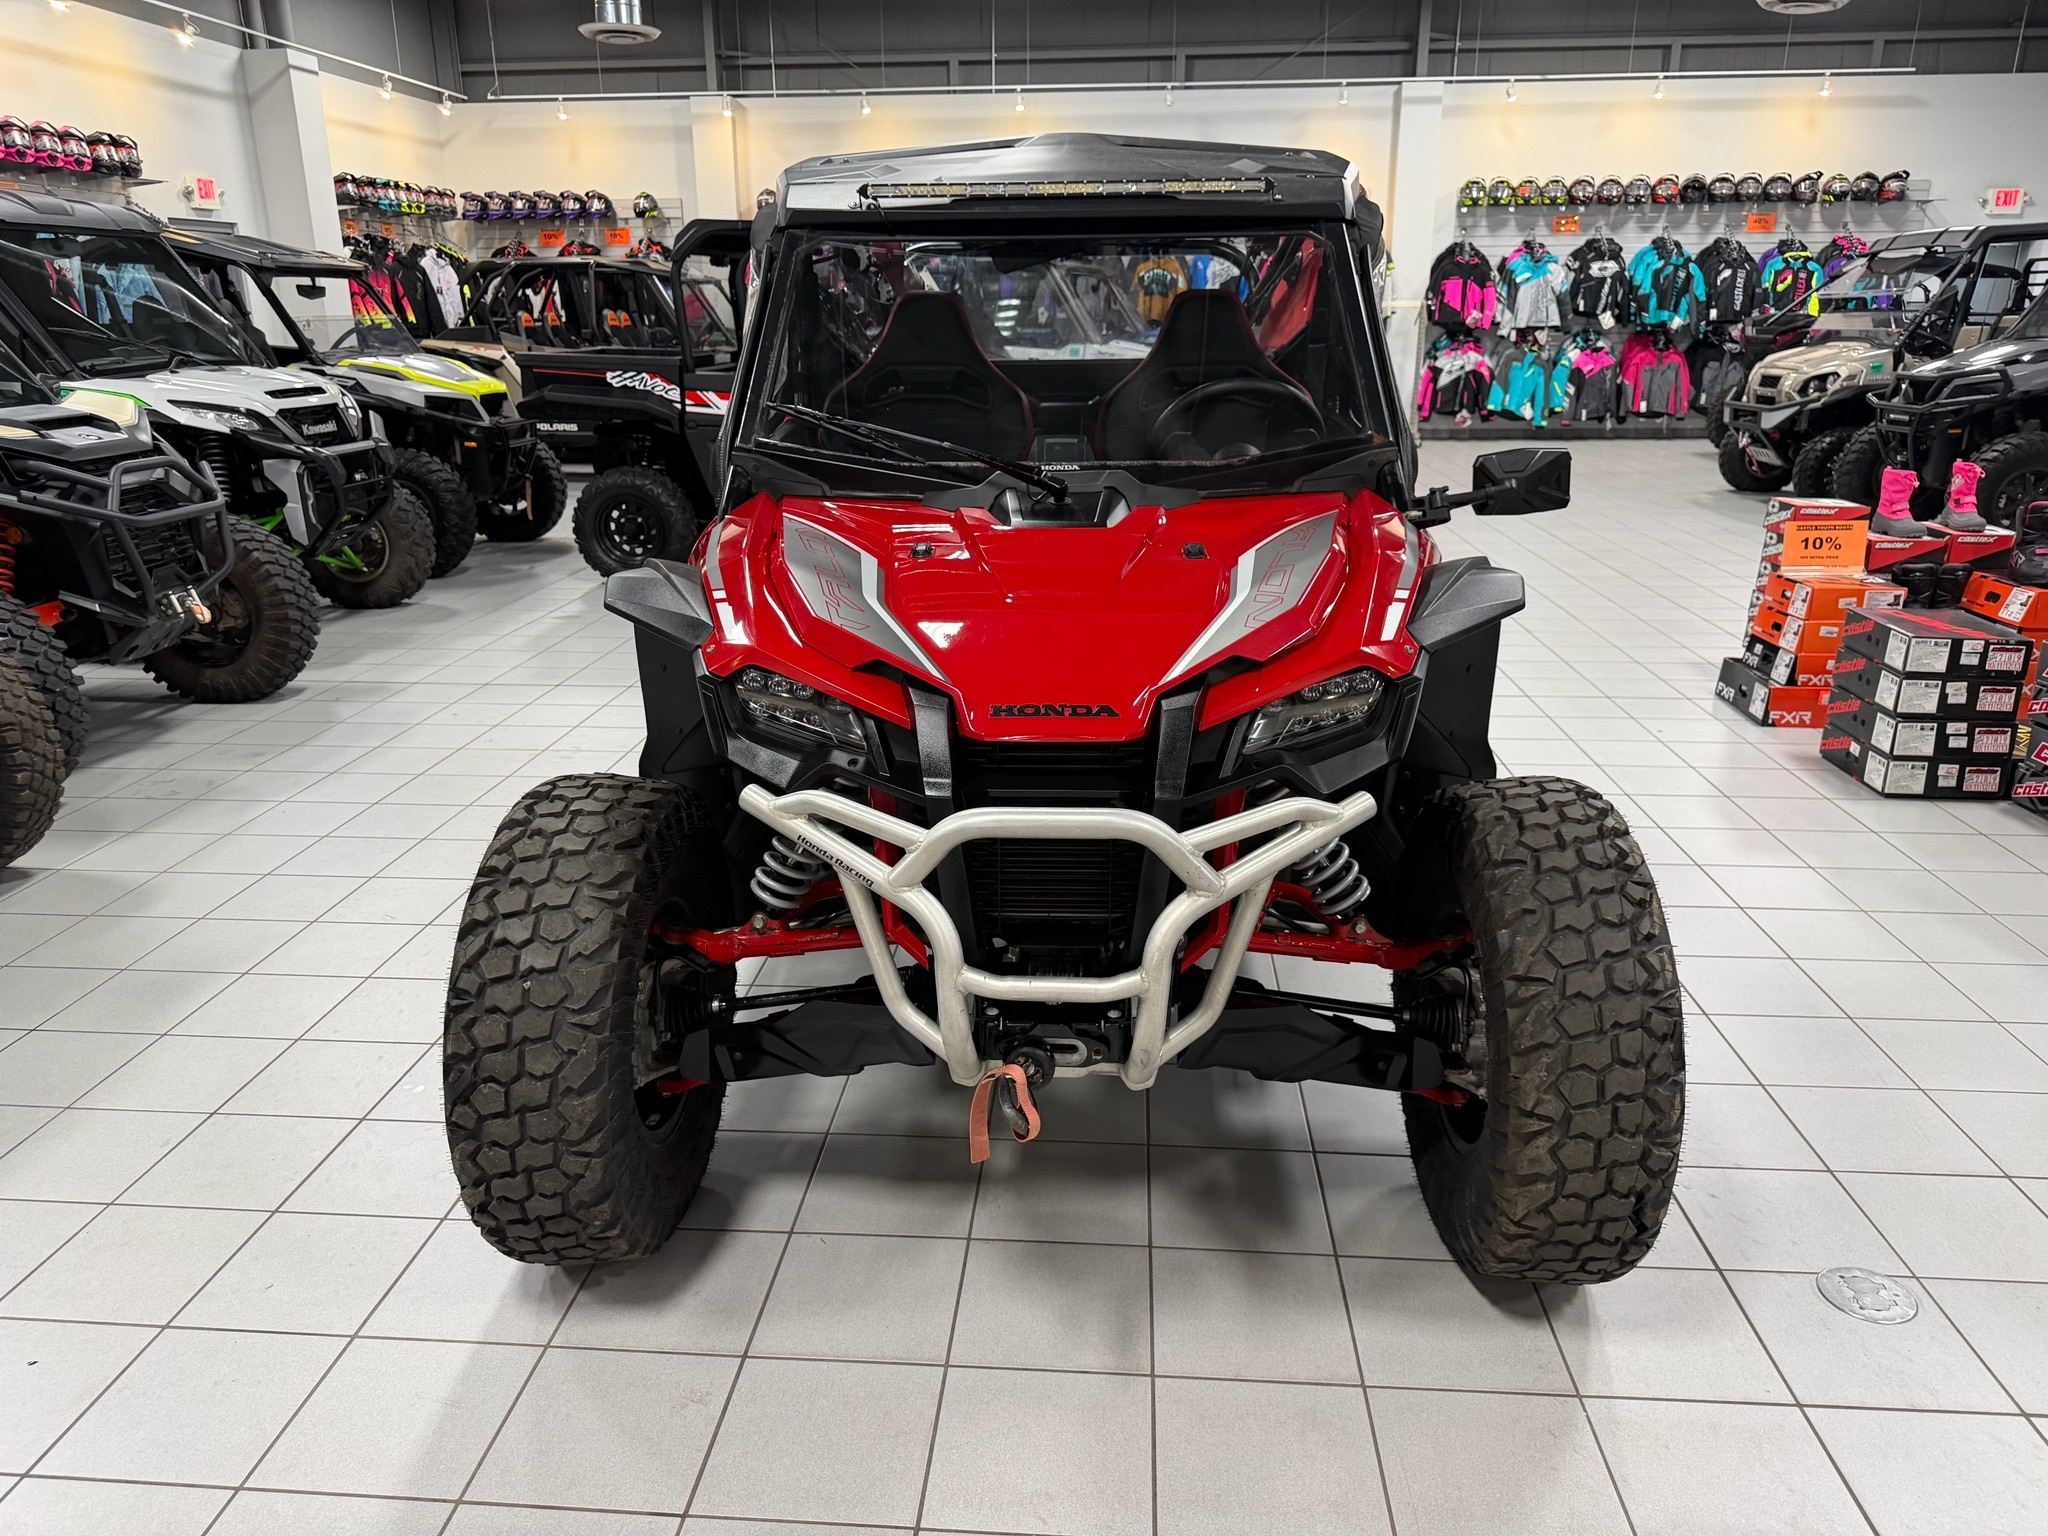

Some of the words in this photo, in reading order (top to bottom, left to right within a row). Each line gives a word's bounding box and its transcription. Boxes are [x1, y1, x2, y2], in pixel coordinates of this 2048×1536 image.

[197, 178, 215, 201] EXIT
[1995, 189, 2020, 207] EXIT
[543, 232, 559, 240] 10%
[302, 420, 338, 436] Kawasaki
[1801, 536, 1842, 551] 10%
[1244, 516, 1325, 629] ALON
[1743, 651, 1760, 669] FXR
[1716, 682, 1735, 702] FXR
[989, 703, 1120, 717] HONDA
[1769, 711, 1812, 725] FXR
[797, 834, 834, 861] Honda
[834, 858, 875, 888] Racing
